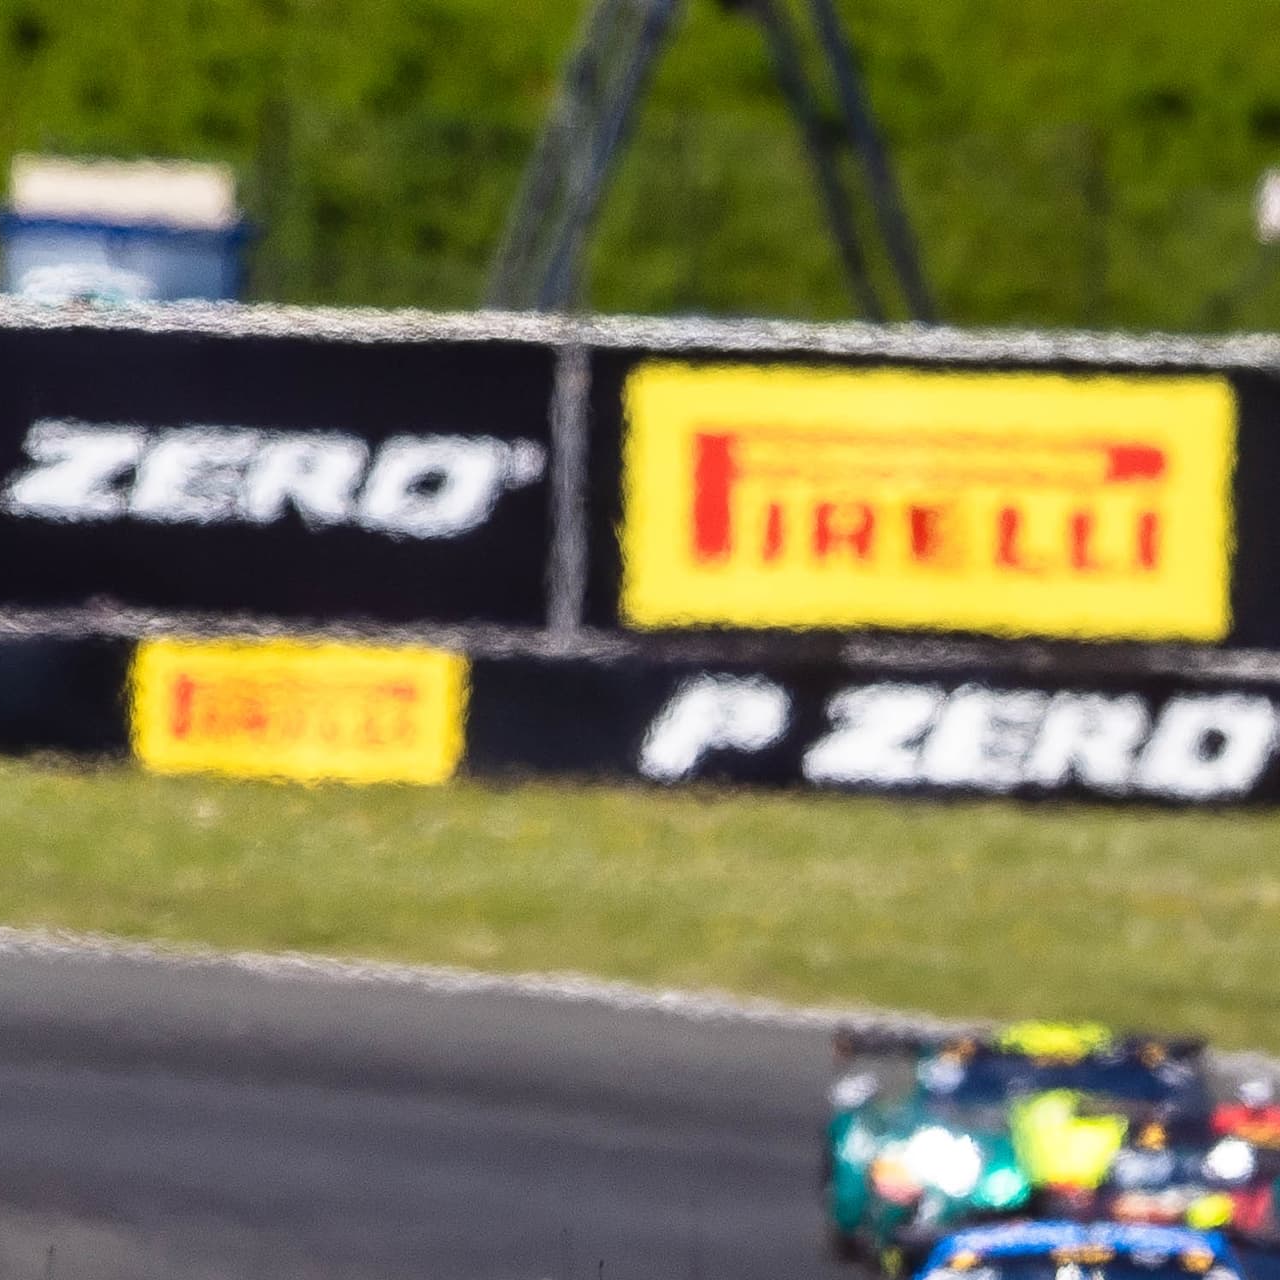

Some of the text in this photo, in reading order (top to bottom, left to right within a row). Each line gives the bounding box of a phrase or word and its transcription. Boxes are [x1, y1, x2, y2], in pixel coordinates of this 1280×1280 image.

[690, 428, 1168, 574] PIRELLI
[640, 674, 1280, 799] P ZERO
